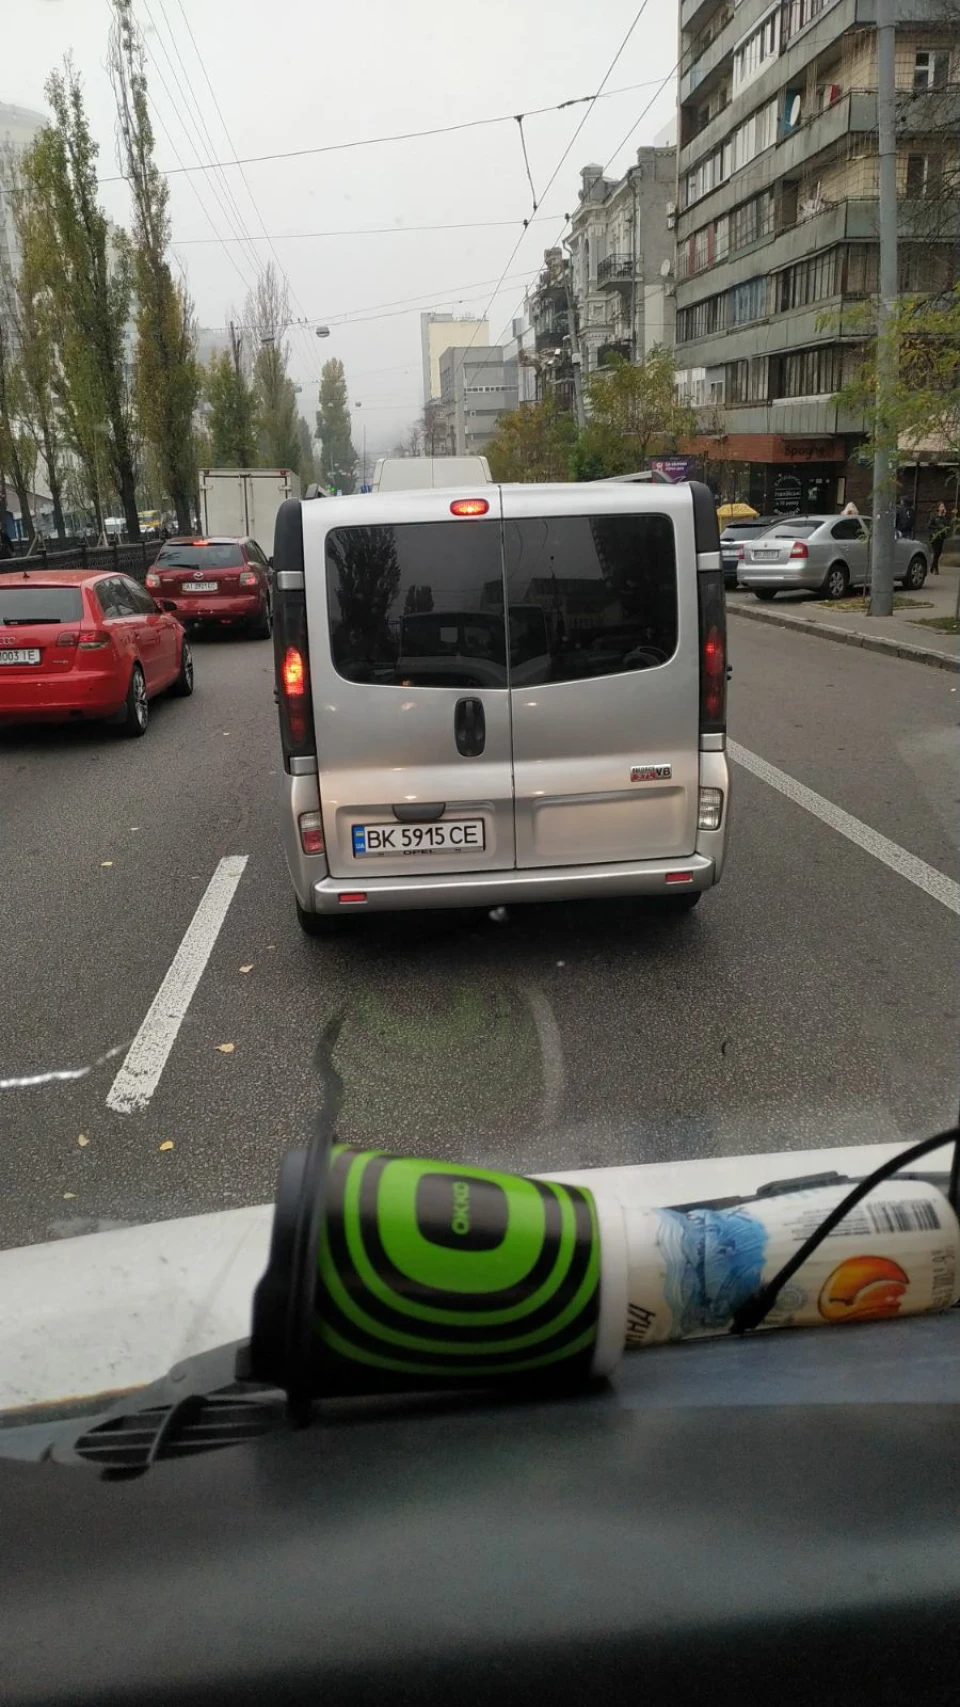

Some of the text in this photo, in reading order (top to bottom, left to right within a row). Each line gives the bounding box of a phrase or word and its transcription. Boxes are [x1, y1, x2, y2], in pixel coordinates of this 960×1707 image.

[0, 651, 19, 661] 003
[367, 825, 478, 849] BK 5915 CE
[452, 1181, 470, 1235] OKKO
